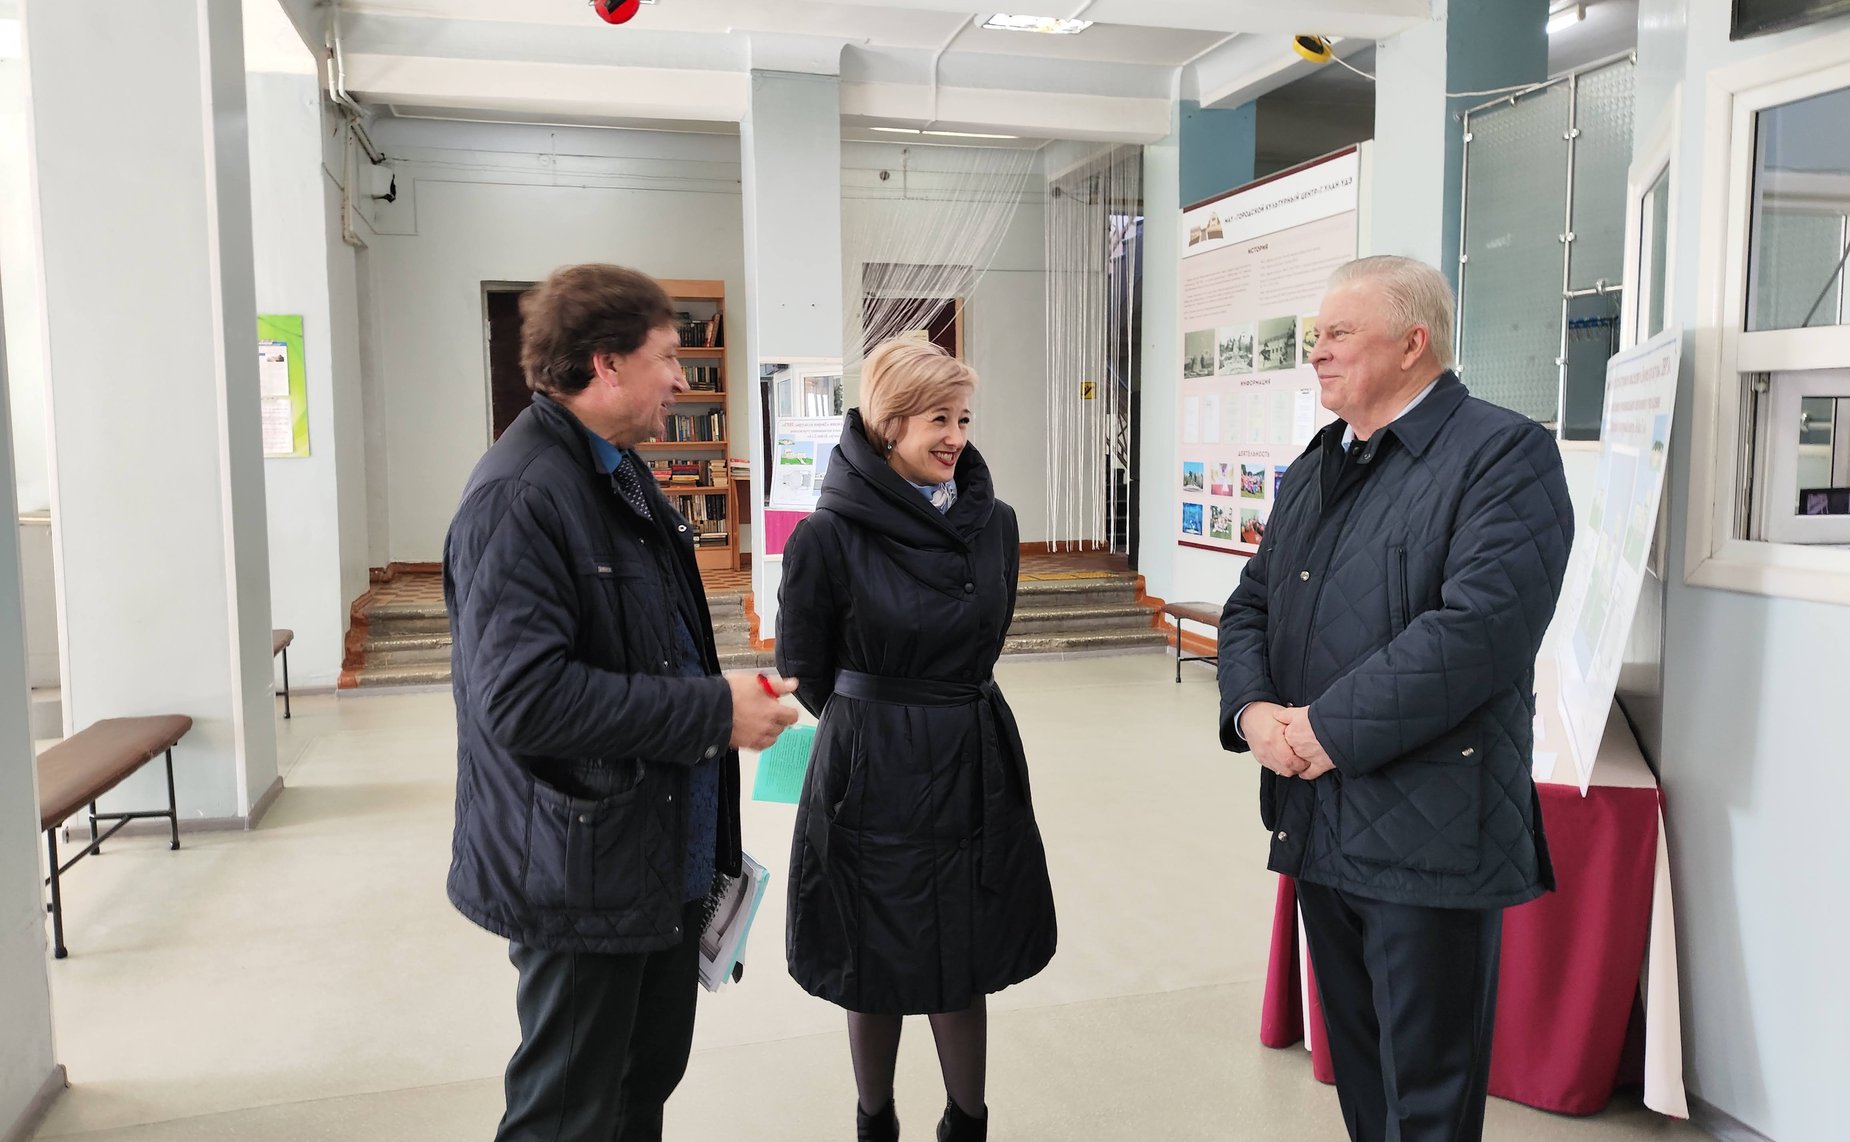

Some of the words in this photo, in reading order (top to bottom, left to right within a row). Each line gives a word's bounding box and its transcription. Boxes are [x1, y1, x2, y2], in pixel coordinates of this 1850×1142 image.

[1247, 243, 1269, 254] ИСТОРИЯ
[1240, 378, 1271, 386] ИНФОРМАЦИЯ
[1238, 450, 1270, 458] ДЕЯТЕЛЬНОСТЬ
